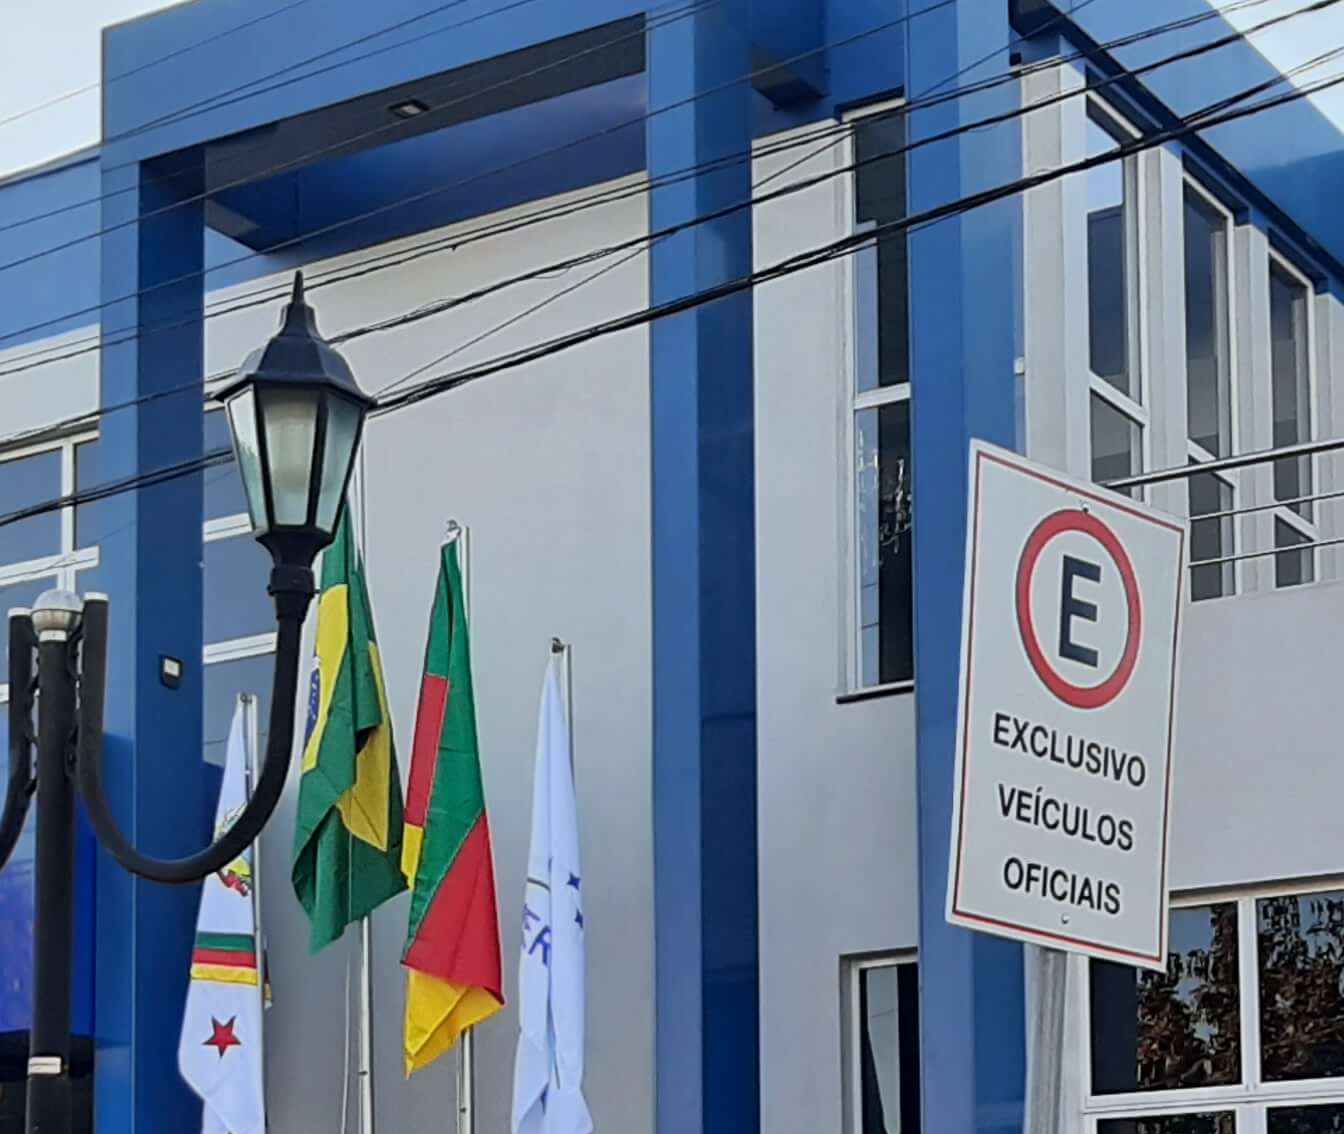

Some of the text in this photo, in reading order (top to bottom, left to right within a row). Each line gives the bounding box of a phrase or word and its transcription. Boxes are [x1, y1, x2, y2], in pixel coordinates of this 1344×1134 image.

[1058, 553, 1102, 669] E
[992, 711, 1147, 787] EXCLUSIVO
[998, 783, 1134, 851] VEÍCULOS
[1002, 856, 1122, 915] OFICIAIS
